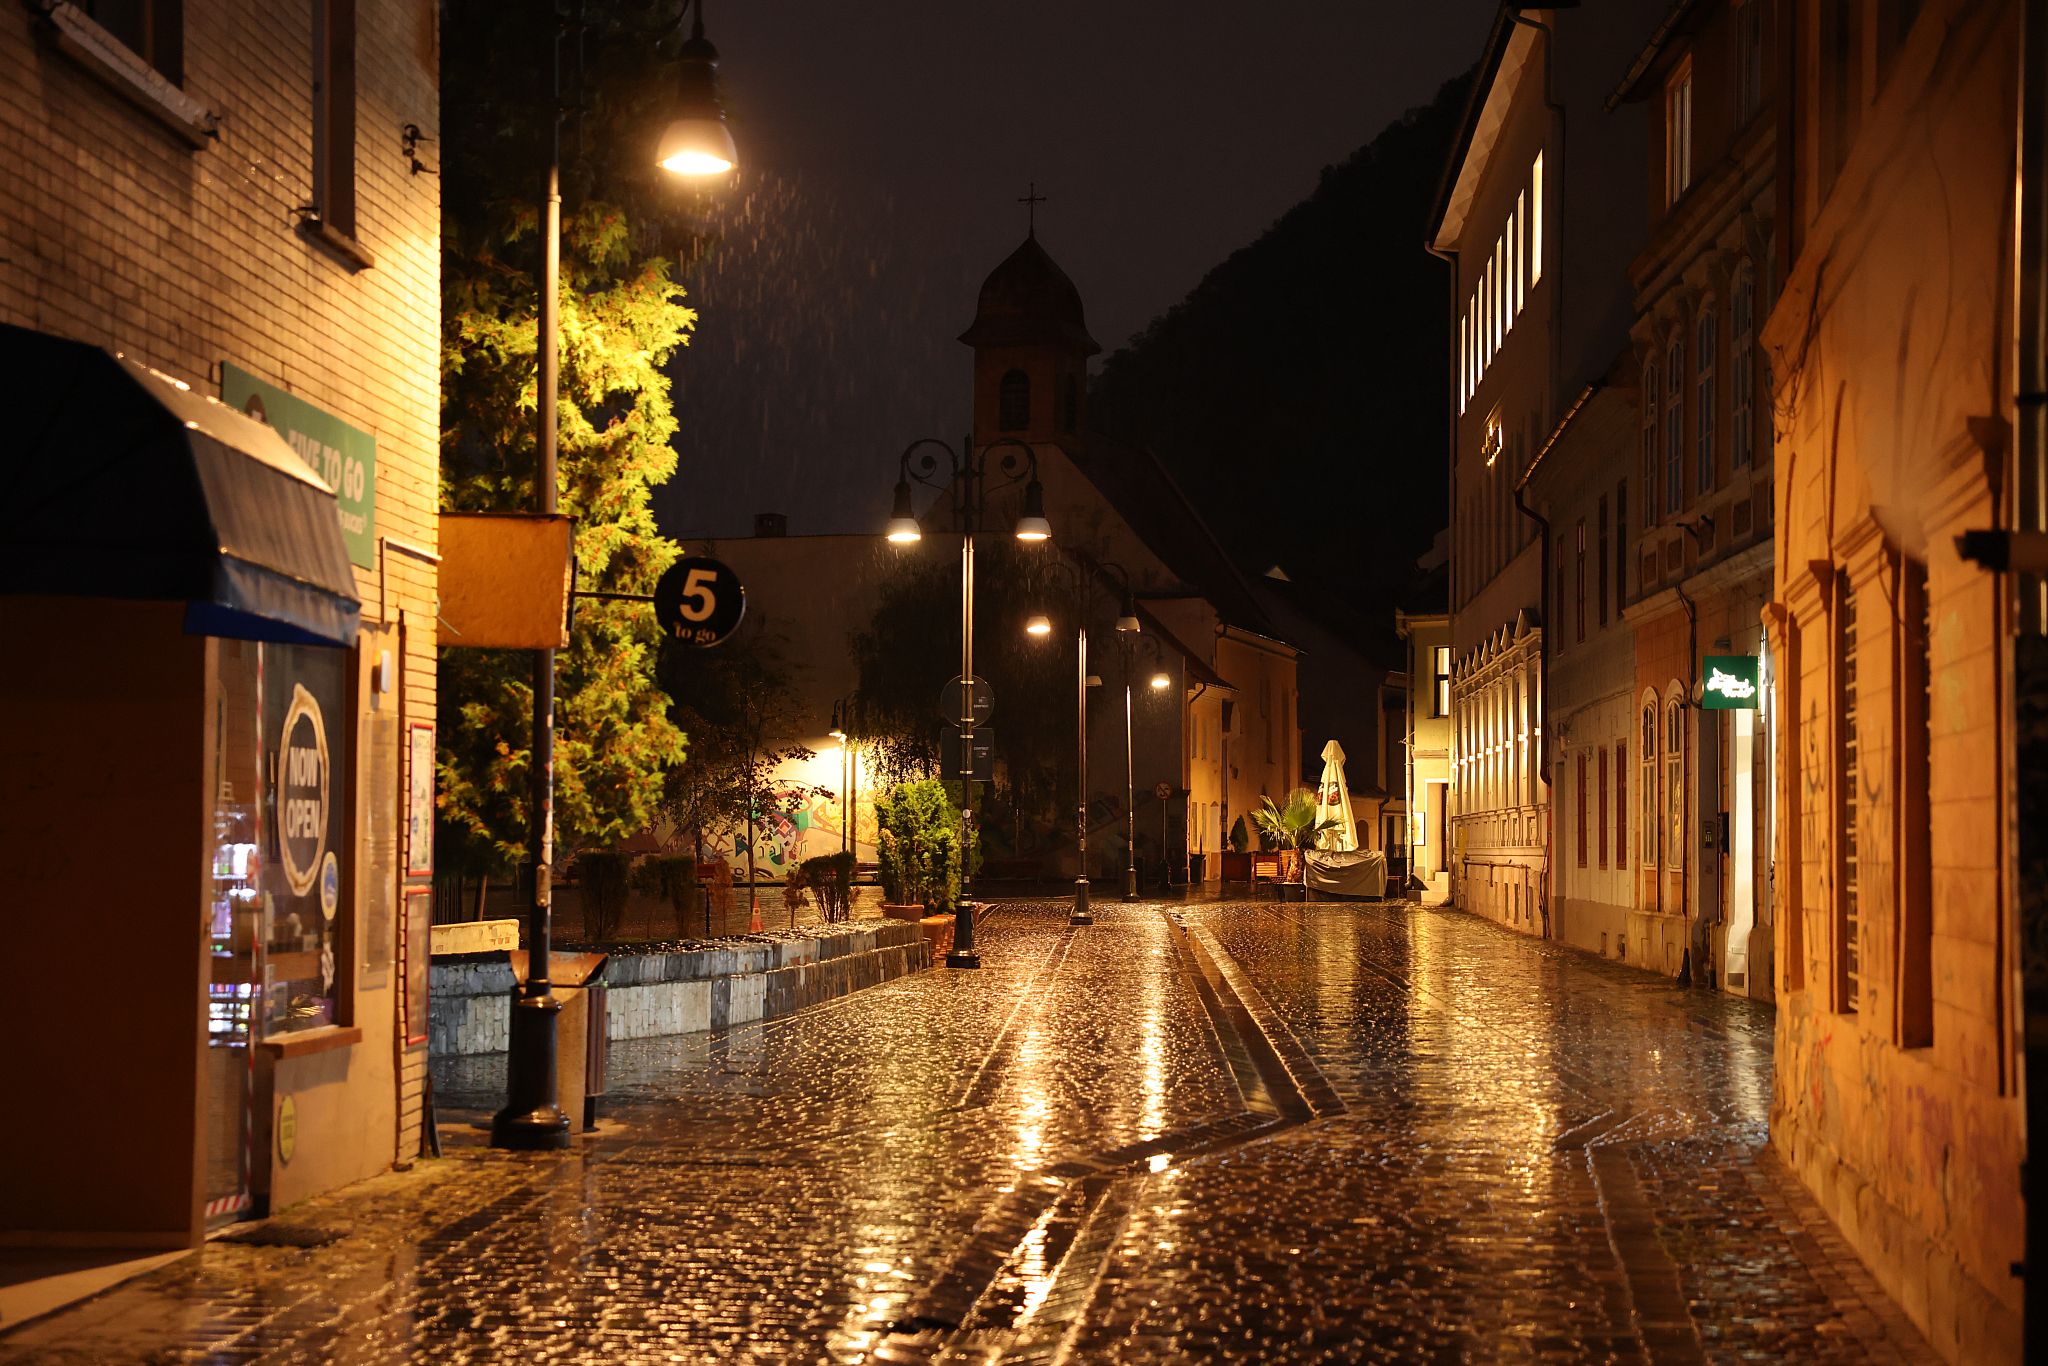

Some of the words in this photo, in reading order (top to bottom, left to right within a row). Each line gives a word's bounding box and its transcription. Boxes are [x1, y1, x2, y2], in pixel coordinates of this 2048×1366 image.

[323, 445, 342, 492] TO
[344, 456, 365, 503] GO
[679, 567, 719, 622] 5
[694, 627, 718, 645] go
[289, 746, 319, 787] NOW
[286, 799, 321, 838] OPEN
